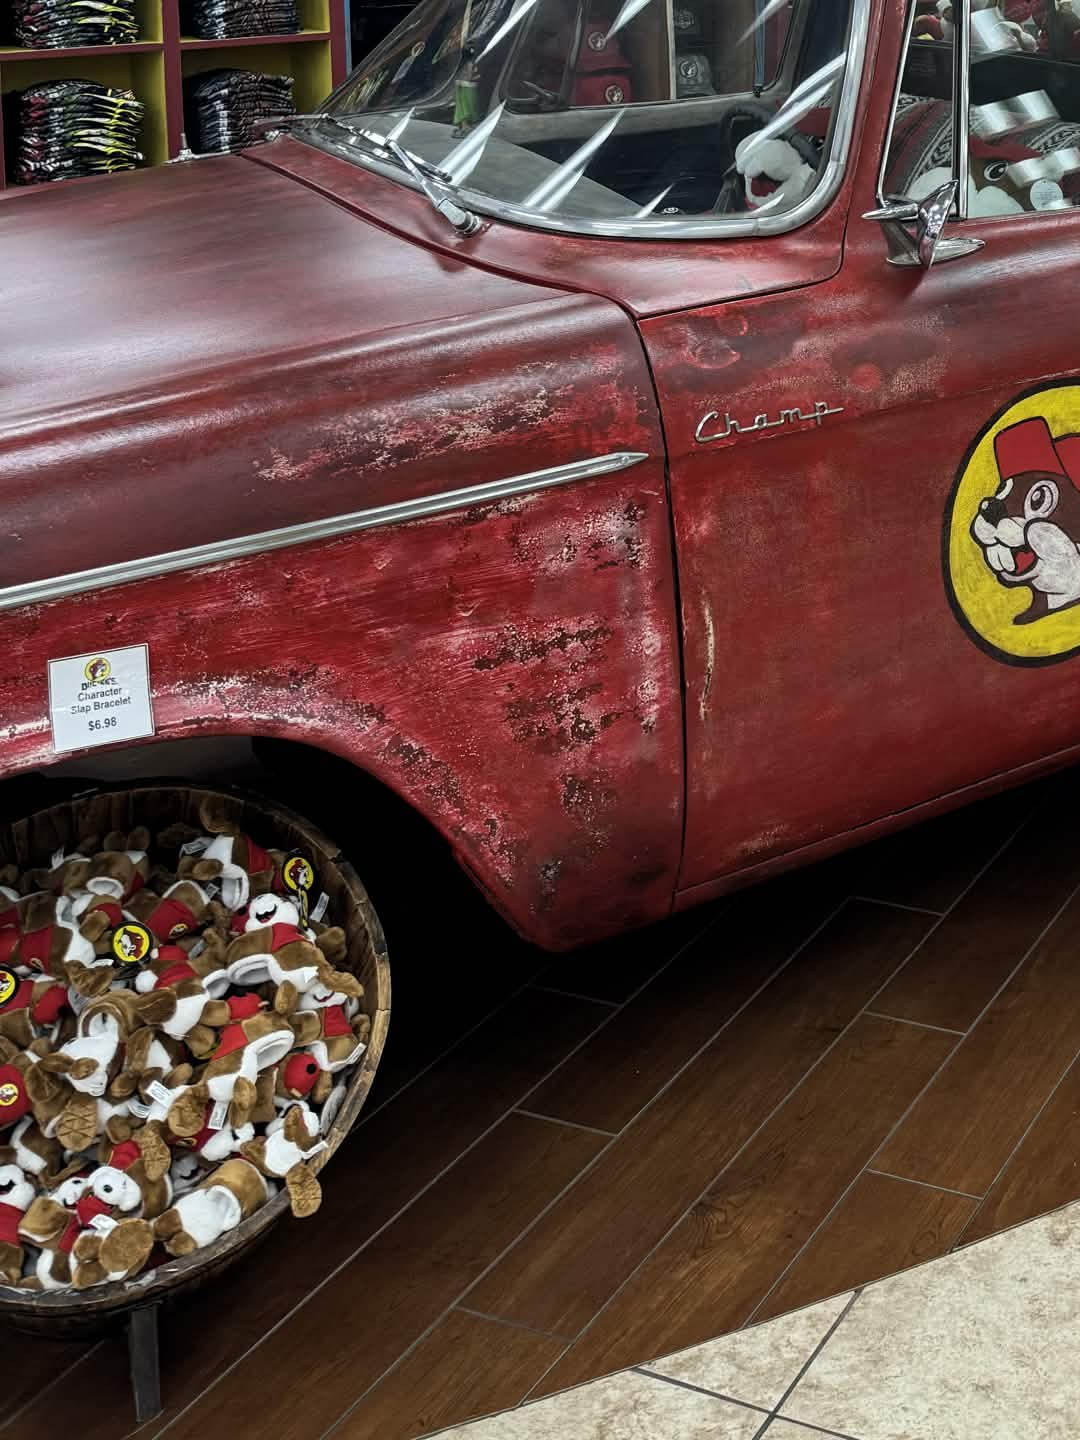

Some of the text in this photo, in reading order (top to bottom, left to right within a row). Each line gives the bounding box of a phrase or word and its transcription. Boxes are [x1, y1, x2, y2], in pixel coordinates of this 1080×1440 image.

[694, 401, 845, 444] Champ
[77, 687, 123, 702] Character
[93, 696, 132, 711] Bracelet
[88, 716, 118, 731] $6.98
